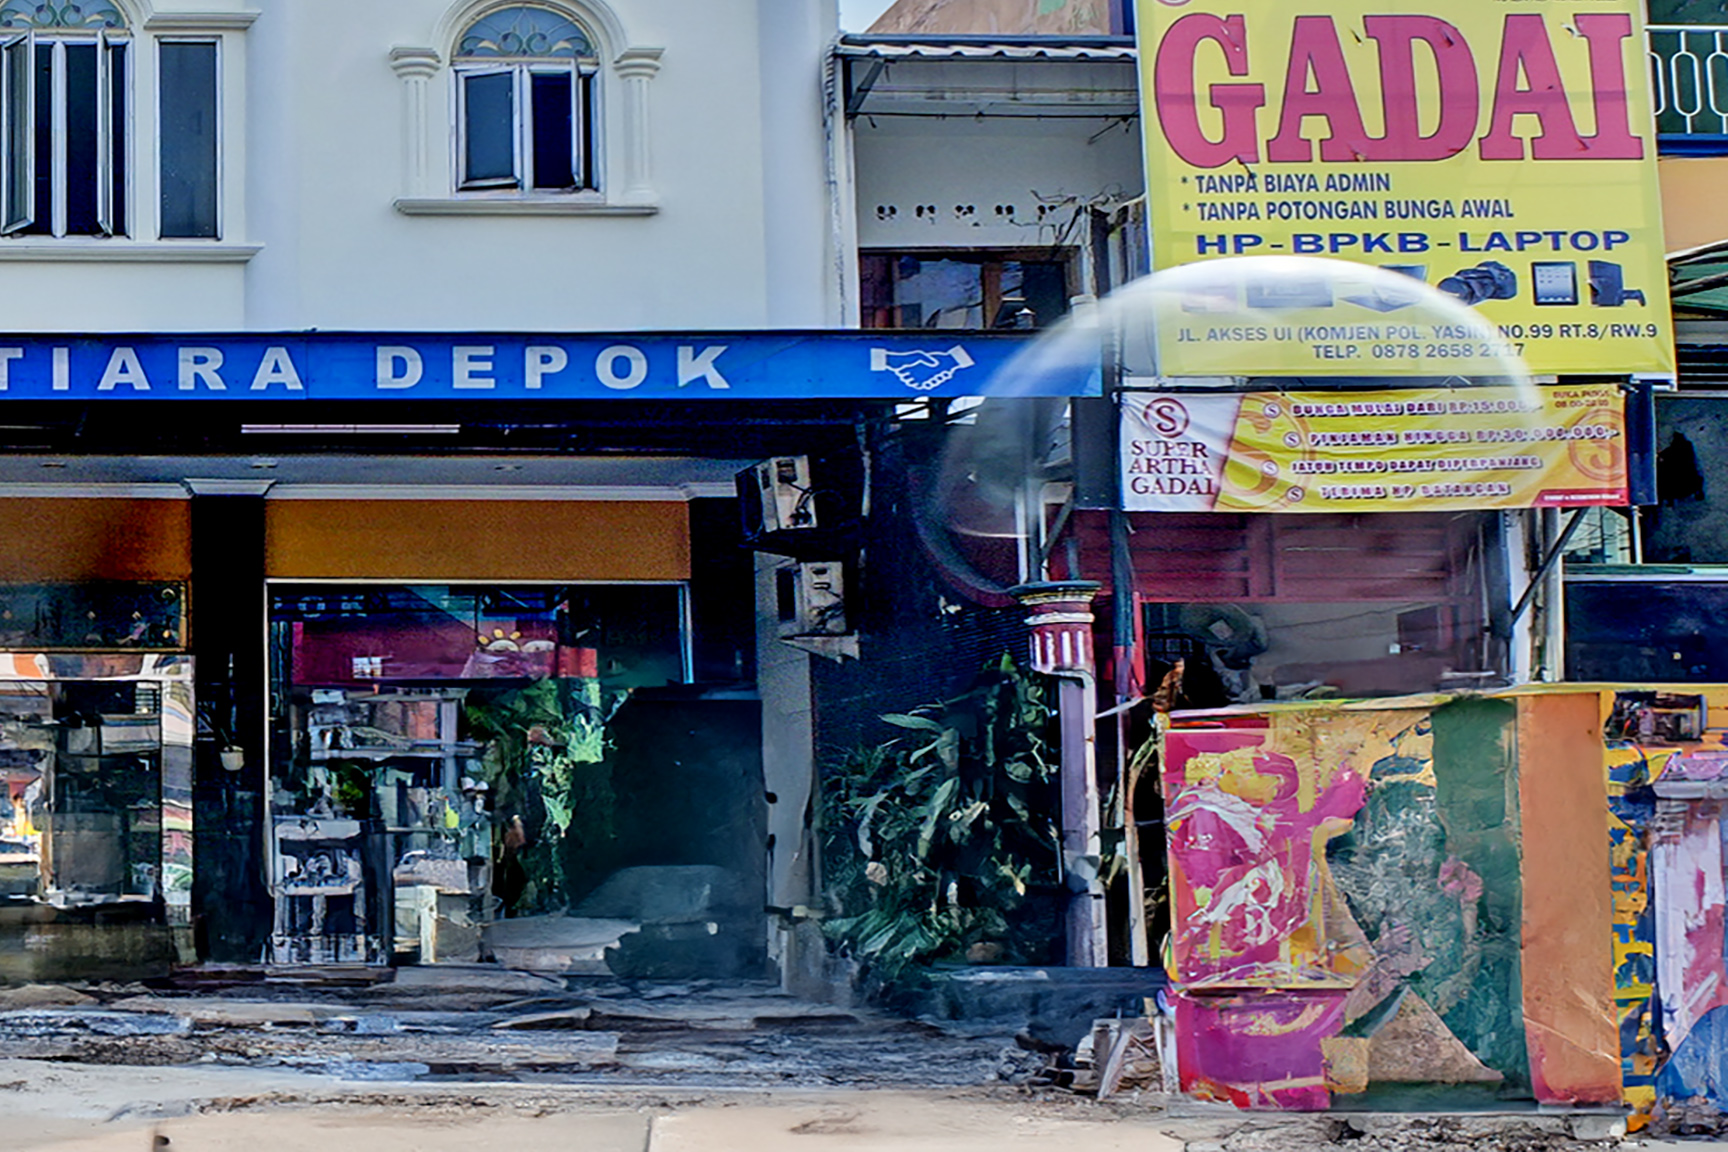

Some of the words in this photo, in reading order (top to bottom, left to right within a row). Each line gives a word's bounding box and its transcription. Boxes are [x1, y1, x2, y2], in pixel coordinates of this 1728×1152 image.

[1154, 13, 1644, 168] GADAI
[1196, 173, 1259, 193] TANPA
[1265, 173, 1320, 193] BIAYA
[1325, 172, 1391, 192] ADMIN
[1197, 202, 1259, 221] TANPA
[1267, 200, 1378, 220] POTONGAN
[1385, 199, 1456, 219] BUNGA
[1461, 198, 1514, 219] AWAL
[1177, 328, 1201, 342] JL.
[1206, 327, 1268, 341] AKSES
[1274, 327, 1292, 341] UI
[1298, 325, 1380, 343] (KOMJEN
[1386, 325, 1426, 340] POL.
[1497, 324, 1554, 339] NO.99
[1559, 323, 1658, 340] RT.8/RW.9
[1312, 344, 1361, 359] TELP.
[1371, 344, 1420, 359] 0878
[1425, 343, 1474, 358] 2658
[376, 345, 731, 392] DEPOK
[1131, 440, 1209, 459] SUPER
[1129, 457, 1213, 475] ARTHA
[1131, 476, 1217, 495] GADAI
